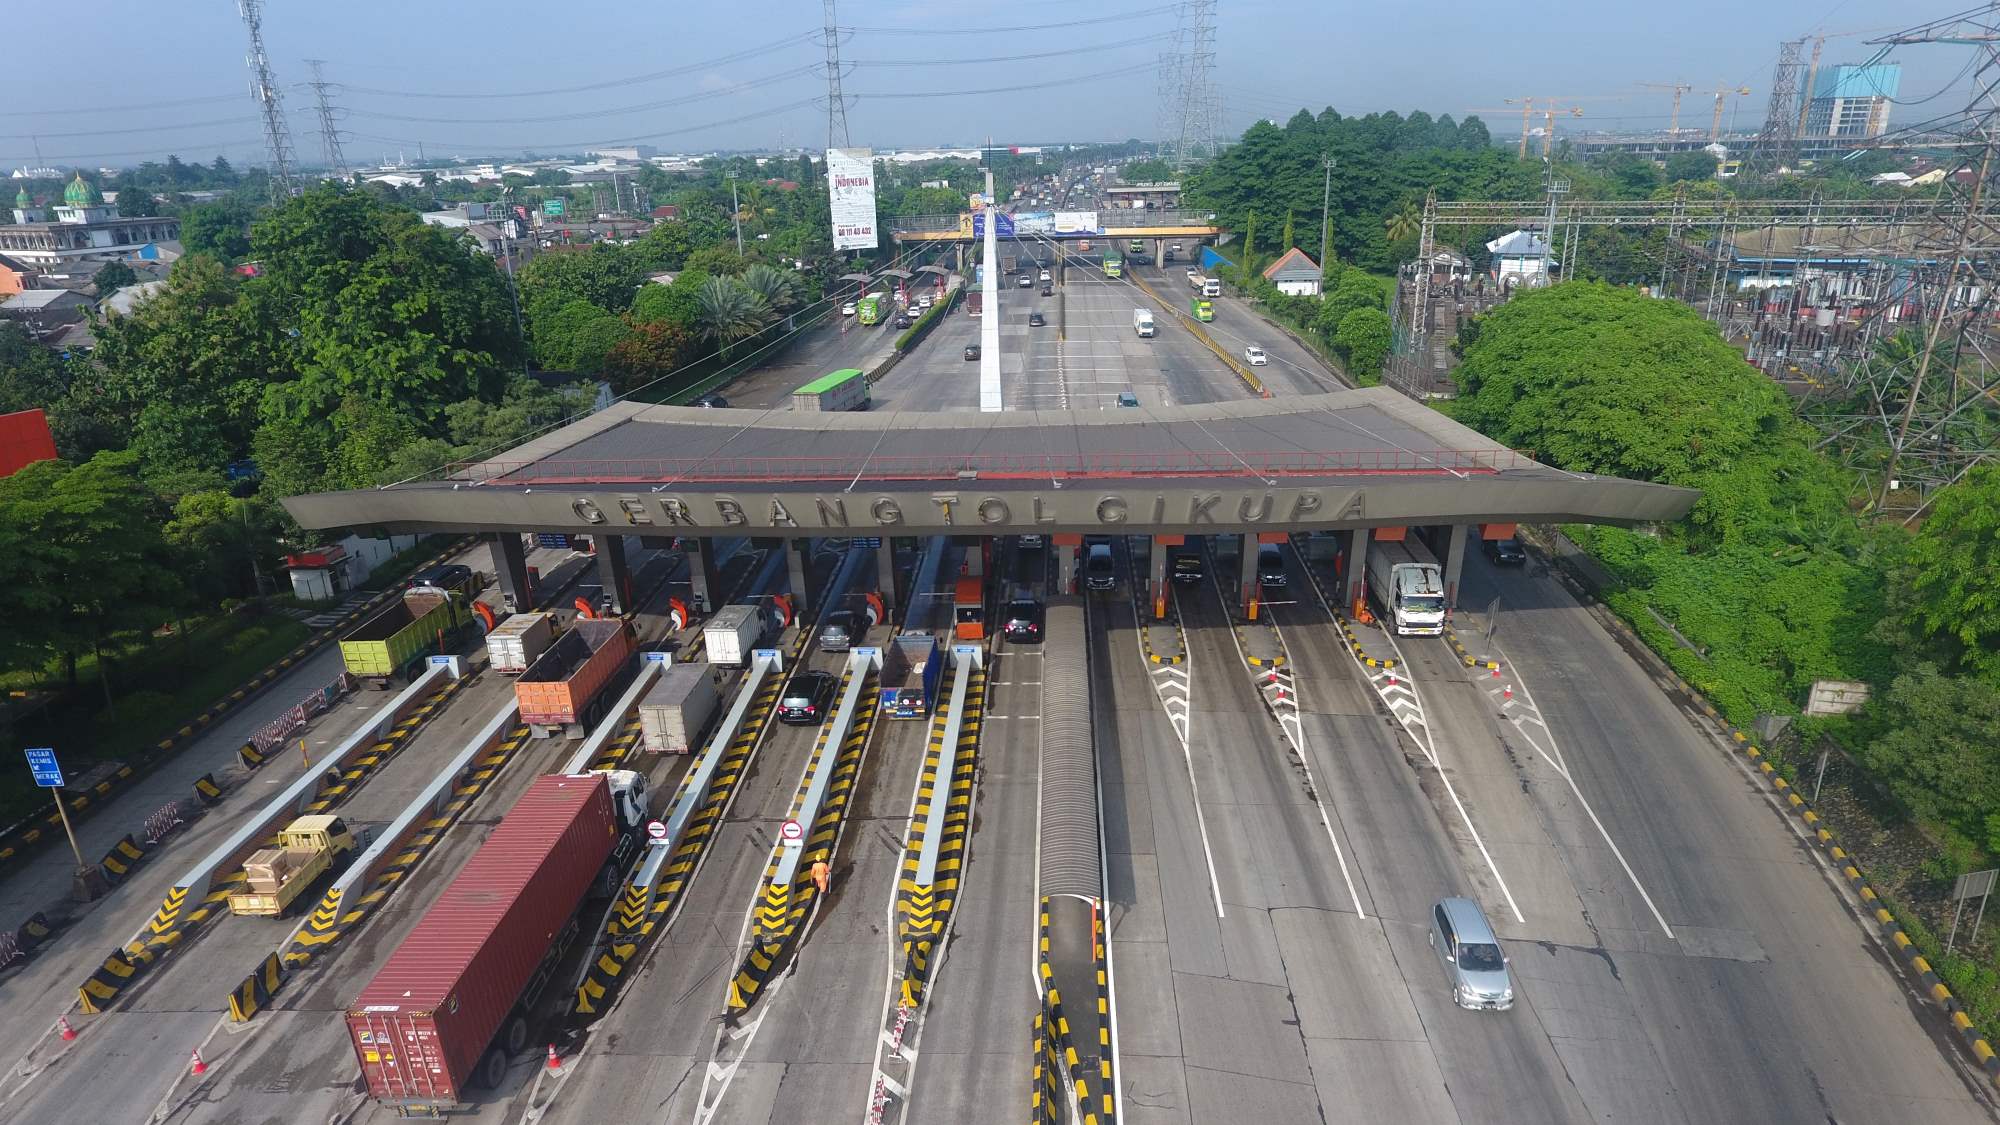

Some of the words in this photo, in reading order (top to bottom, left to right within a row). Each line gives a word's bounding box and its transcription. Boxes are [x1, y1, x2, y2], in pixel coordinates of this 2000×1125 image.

[571, 496, 903, 528] GERBANG
[931, 494, 1056, 526] TOL
[1096, 489, 1369, 524] CIKUPA
